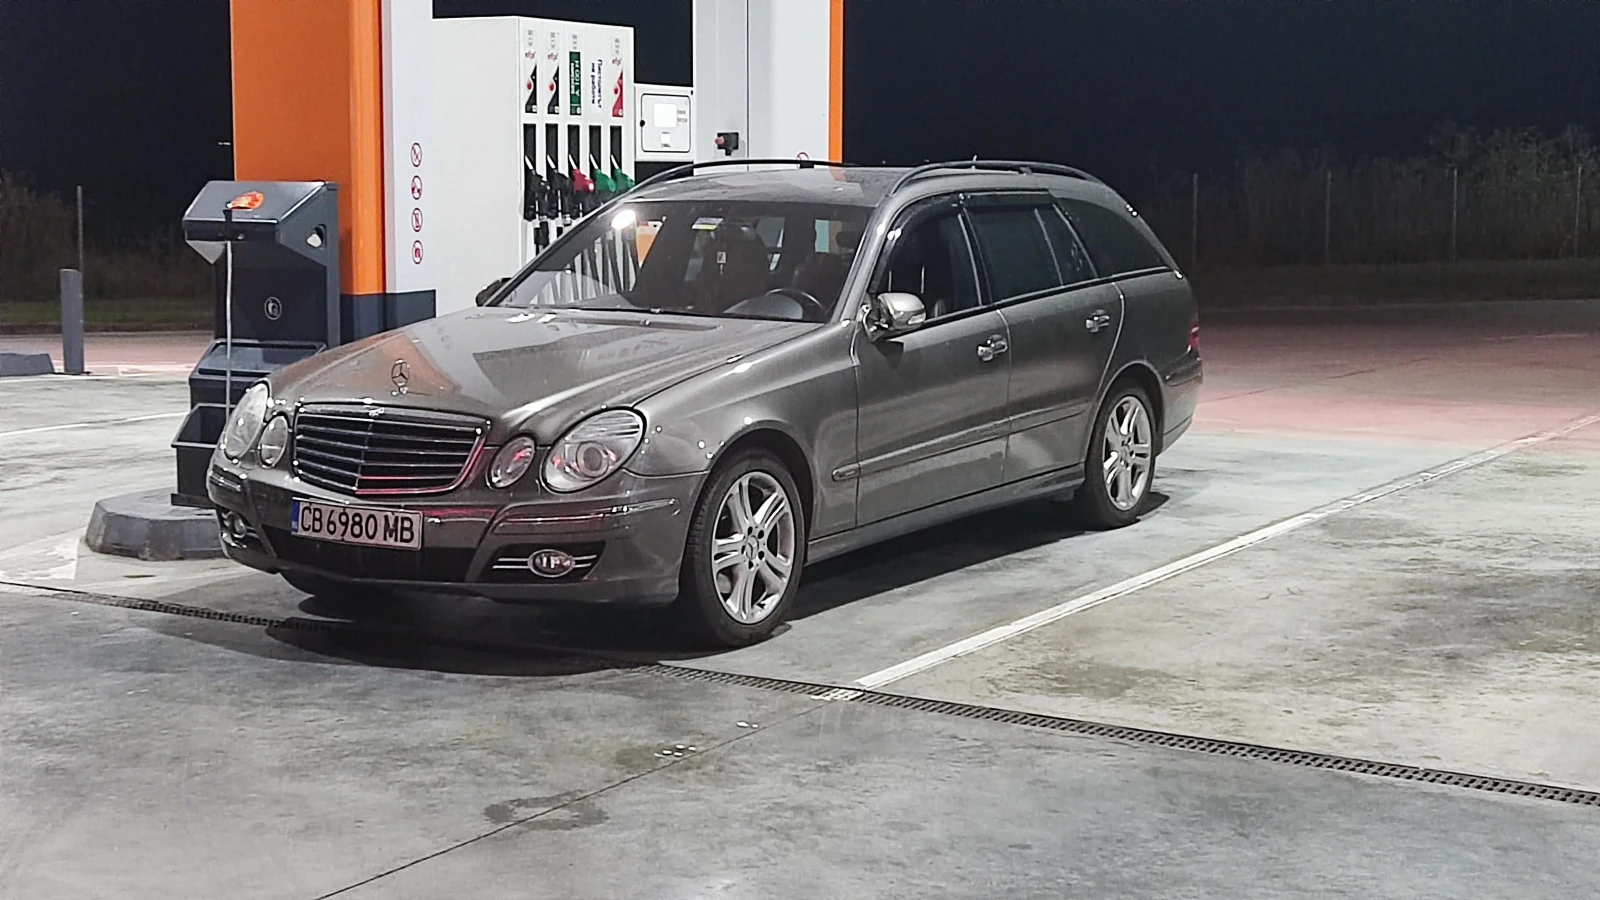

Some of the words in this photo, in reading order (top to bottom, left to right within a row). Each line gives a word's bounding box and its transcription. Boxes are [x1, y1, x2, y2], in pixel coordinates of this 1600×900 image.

[301, 506, 323, 533] CB
[326, 510, 378, 540] 6980
[383, 514, 414, 543] MB
